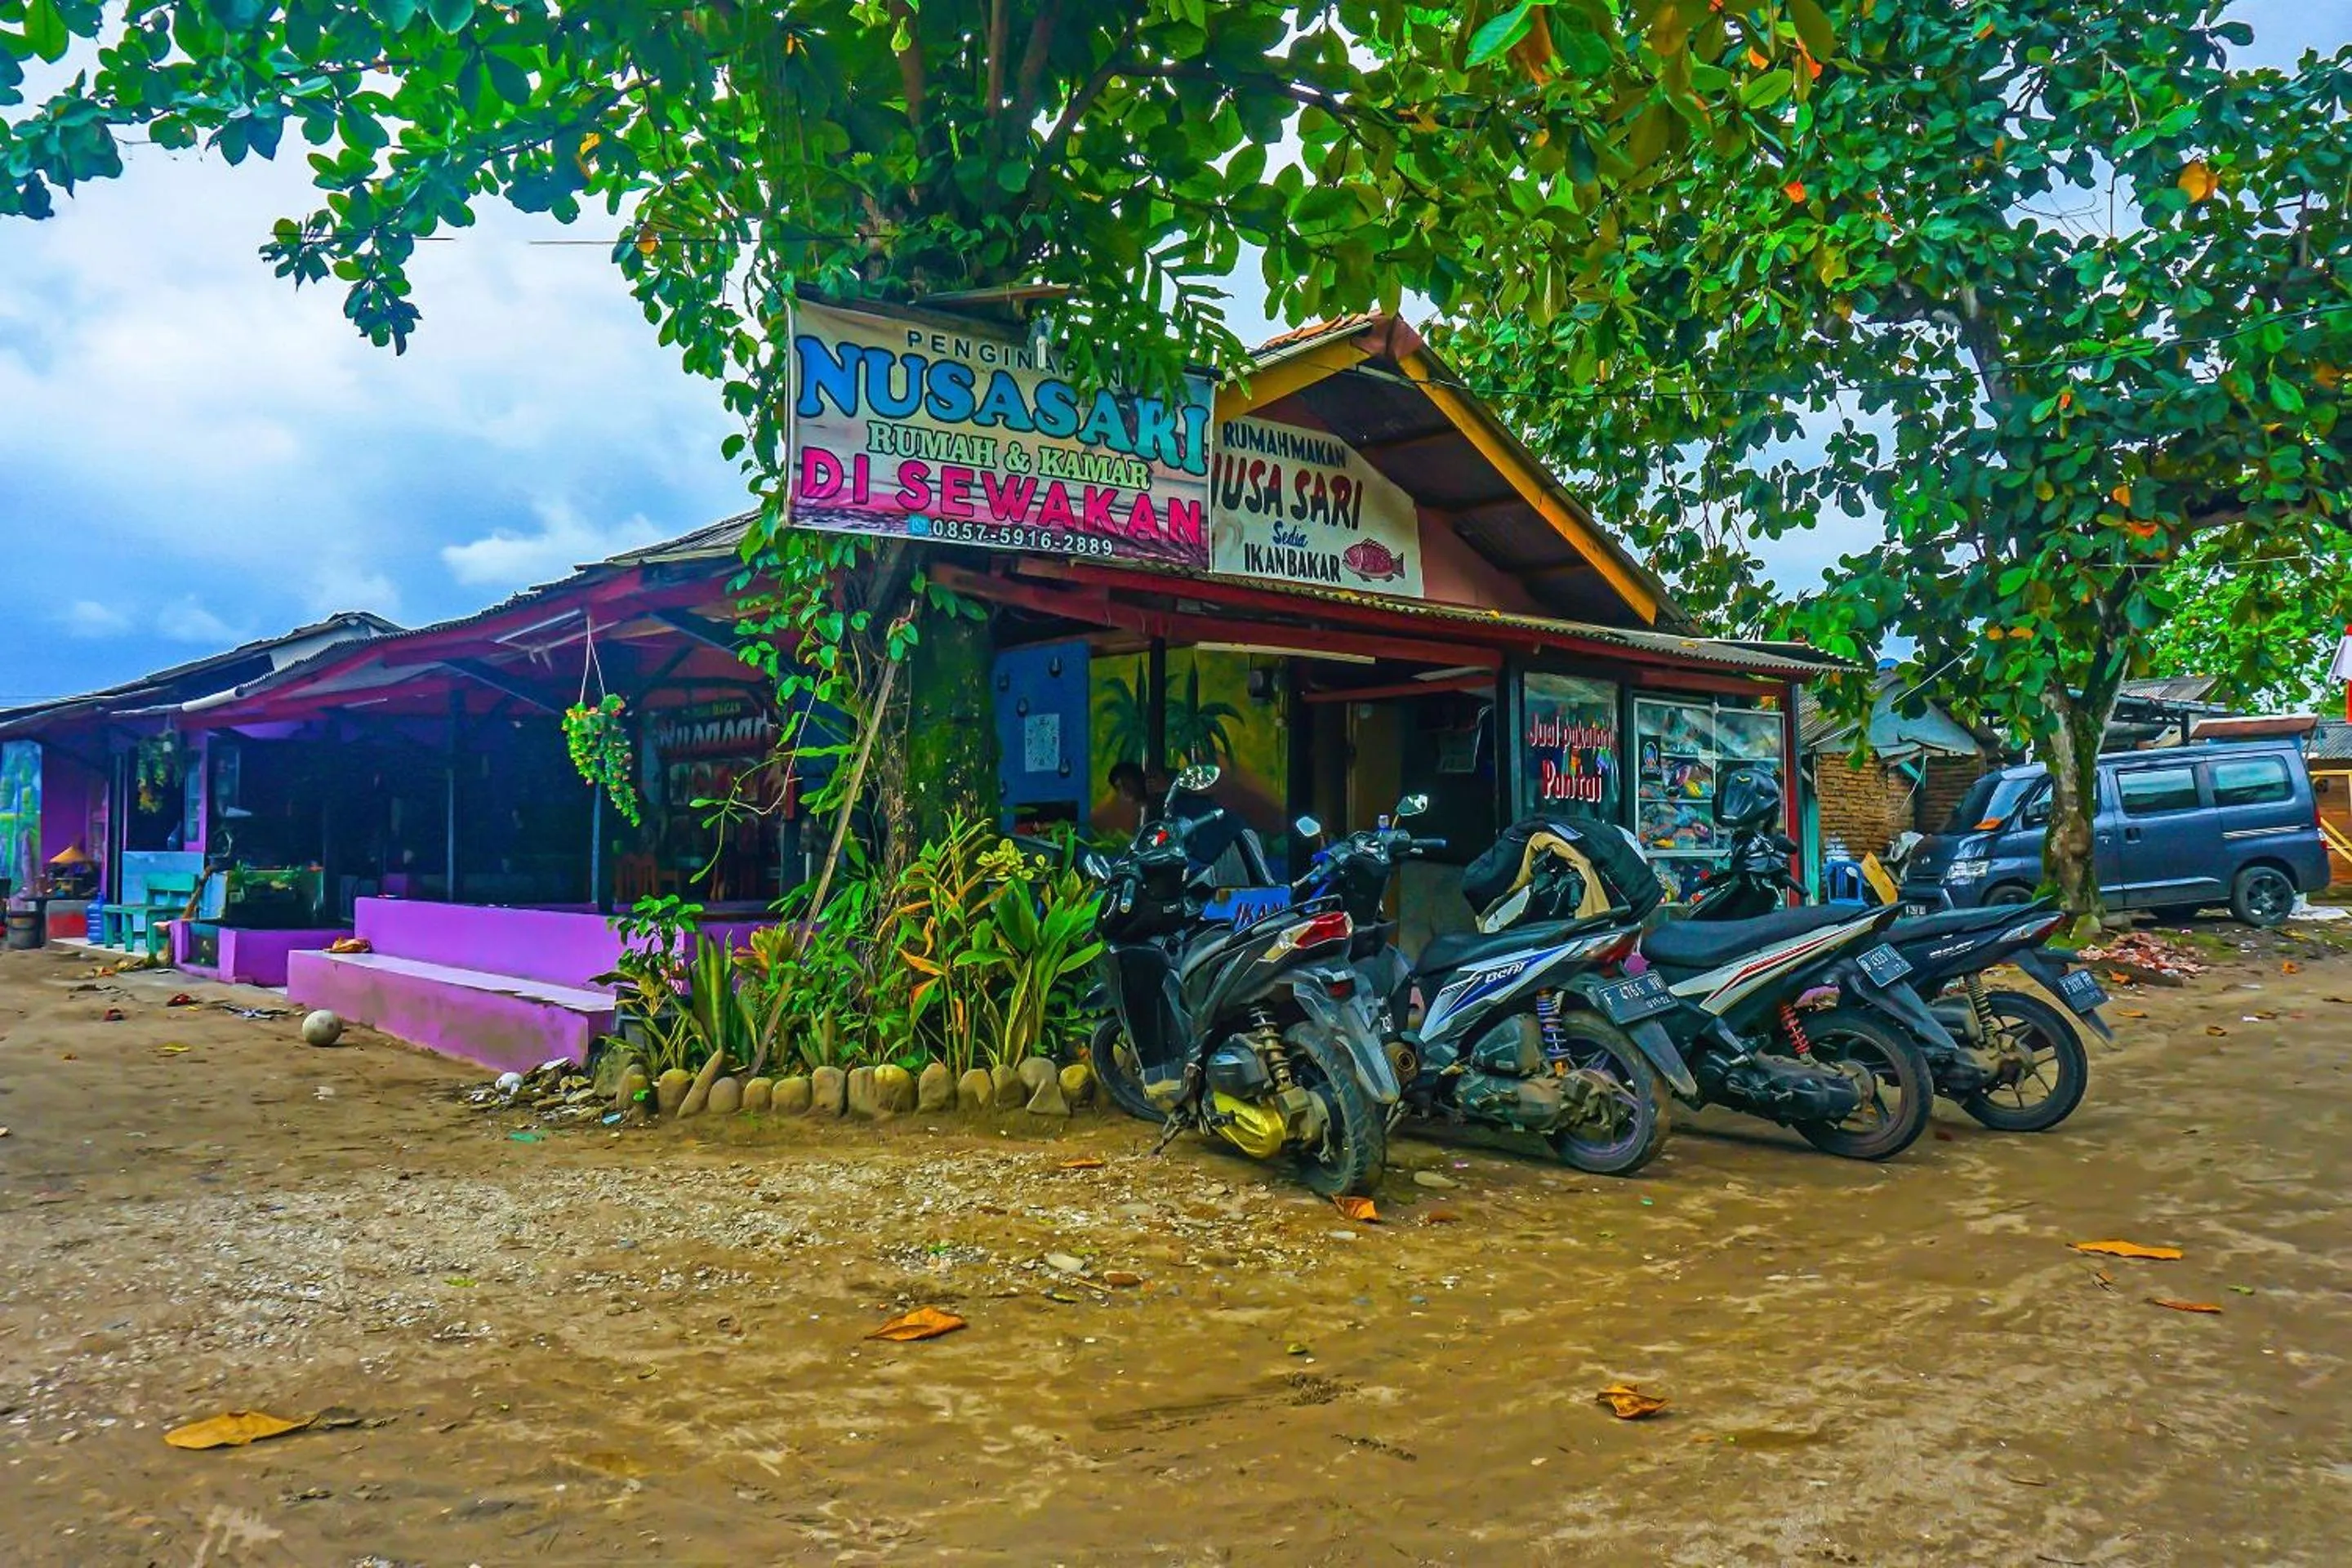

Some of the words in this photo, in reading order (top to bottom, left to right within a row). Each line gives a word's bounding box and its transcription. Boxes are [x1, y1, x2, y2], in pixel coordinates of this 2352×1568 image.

[906, 328, 1123, 387] PENGINAPN
[794, 335, 1210, 477] NUSASARI
[866, 420, 997, 469] RUMAH
[1004, 442, 1031, 473] &
[1039, 446, 1153, 491] KAMAR
[800, 445, 870, 506] DI
[895, 459, 1204, 546] SEWAKAN
[1290, 468, 1363, 531] SARI
[931, 519, 1114, 556] 0857-5916-2889
[1272, 520, 1308, 548] Sedia
